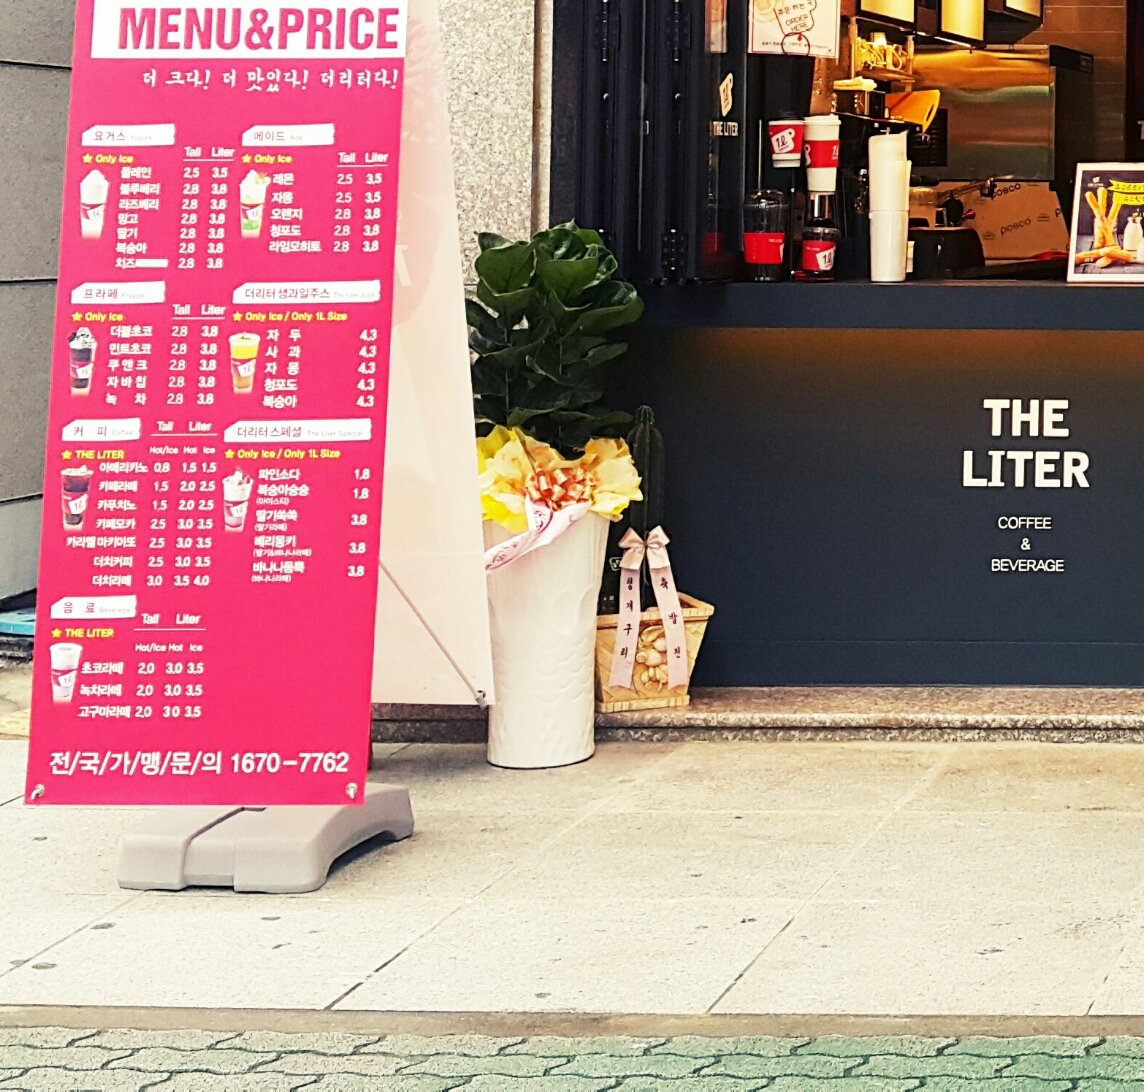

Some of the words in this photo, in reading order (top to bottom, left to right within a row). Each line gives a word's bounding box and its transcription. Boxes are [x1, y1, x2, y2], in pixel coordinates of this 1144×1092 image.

[786, 14, 808, 26] ORDER
[118, 7, 400, 50] MENU&PRICE
[143, 69, 156, 88] 더
[165, 69, 211, 90] 크다!
[223, 69, 236, 88] 더
[96, 154, 116, 164] Only
[184, 147, 201, 157] Tall
[211, 147, 235, 157] Liter
[255, 154, 275, 164] Only
[338, 152, 356, 163] Tall
[365, 152, 389, 163] Liter
[245, 312, 266, 322] Only
[292, 312, 312, 322] Only
[328, 312, 348, 321] Size
[983, 399, 1069, 437] THE
[75, 450, 95, 459] THE
[97, 450, 124, 459] LITER
[963, 450, 1090, 487] LITER
[998, 517, 1052, 529] COFFEE
[1021, 538, 1030, 550] &
[991, 559, 1064, 572] BEVERAGE
[231, 752, 349, 773] 1670-7762
